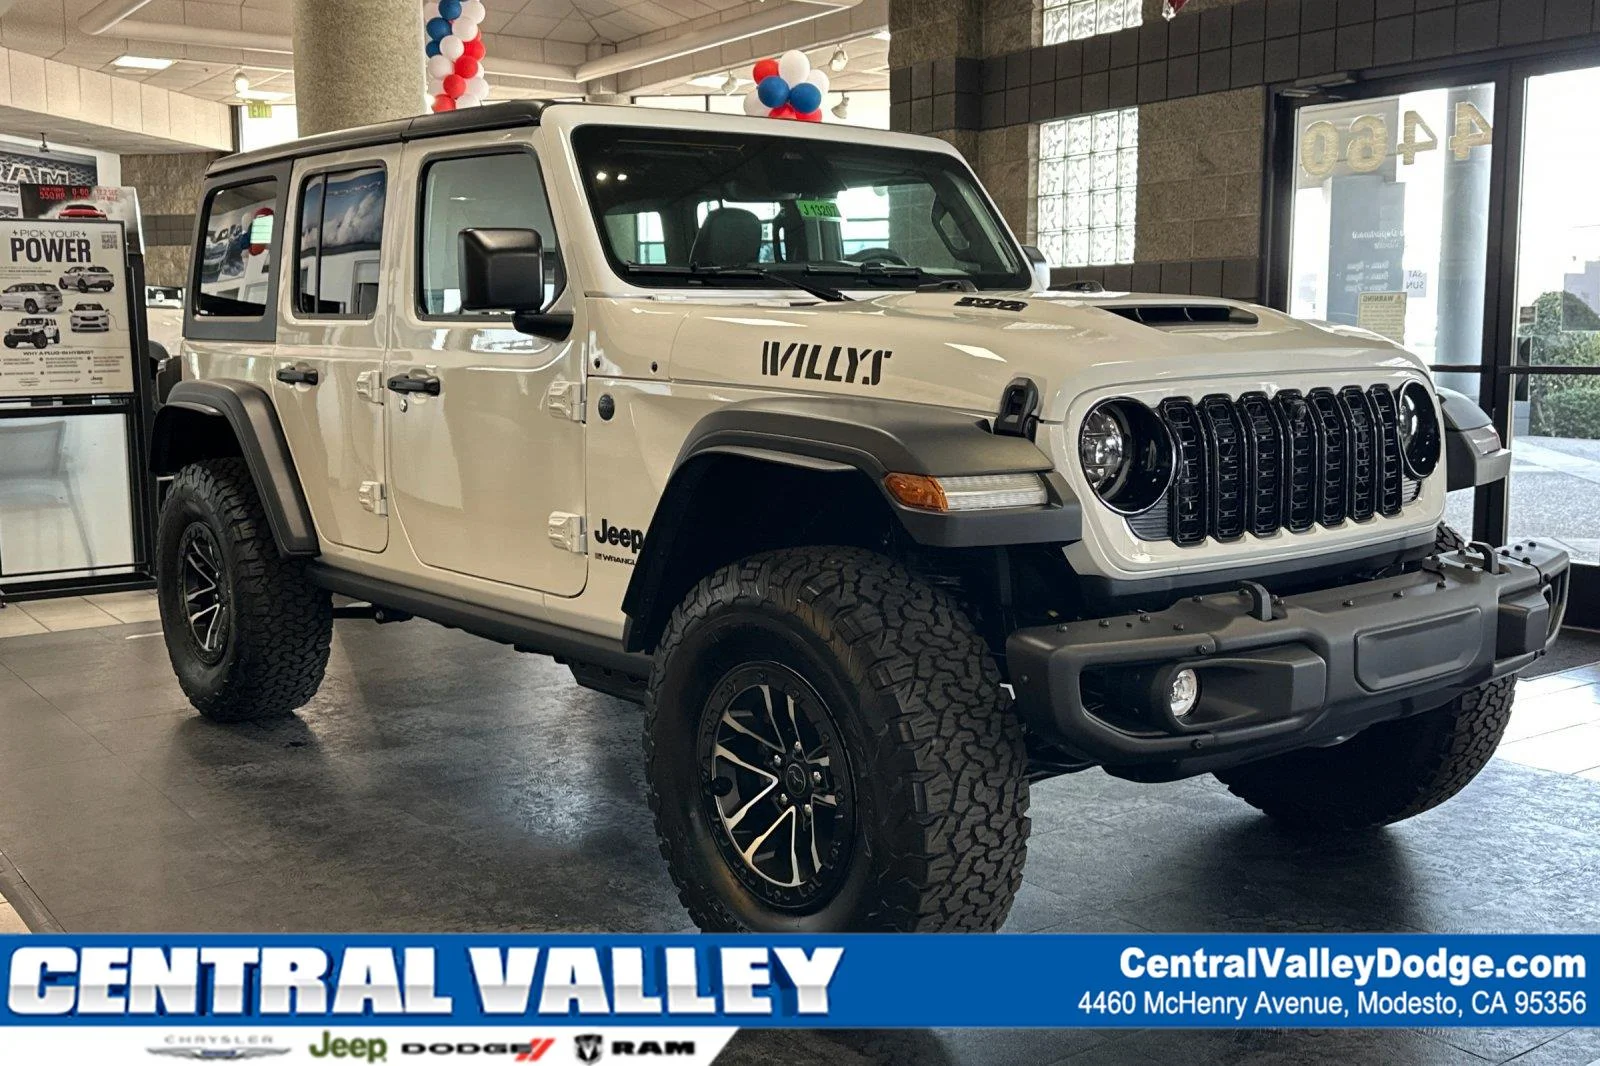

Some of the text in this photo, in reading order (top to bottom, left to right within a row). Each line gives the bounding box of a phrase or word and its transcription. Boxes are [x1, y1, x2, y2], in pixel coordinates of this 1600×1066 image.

[0, 161, 70, 185] AM
[20, 229, 80, 238] PICK YOUR
[10, 237, 91, 263] POWER
[762, 341, 893, 386] WILLYS
[594, 518, 645, 550] Jeep
[602, 554, 637, 566] WRANGL
